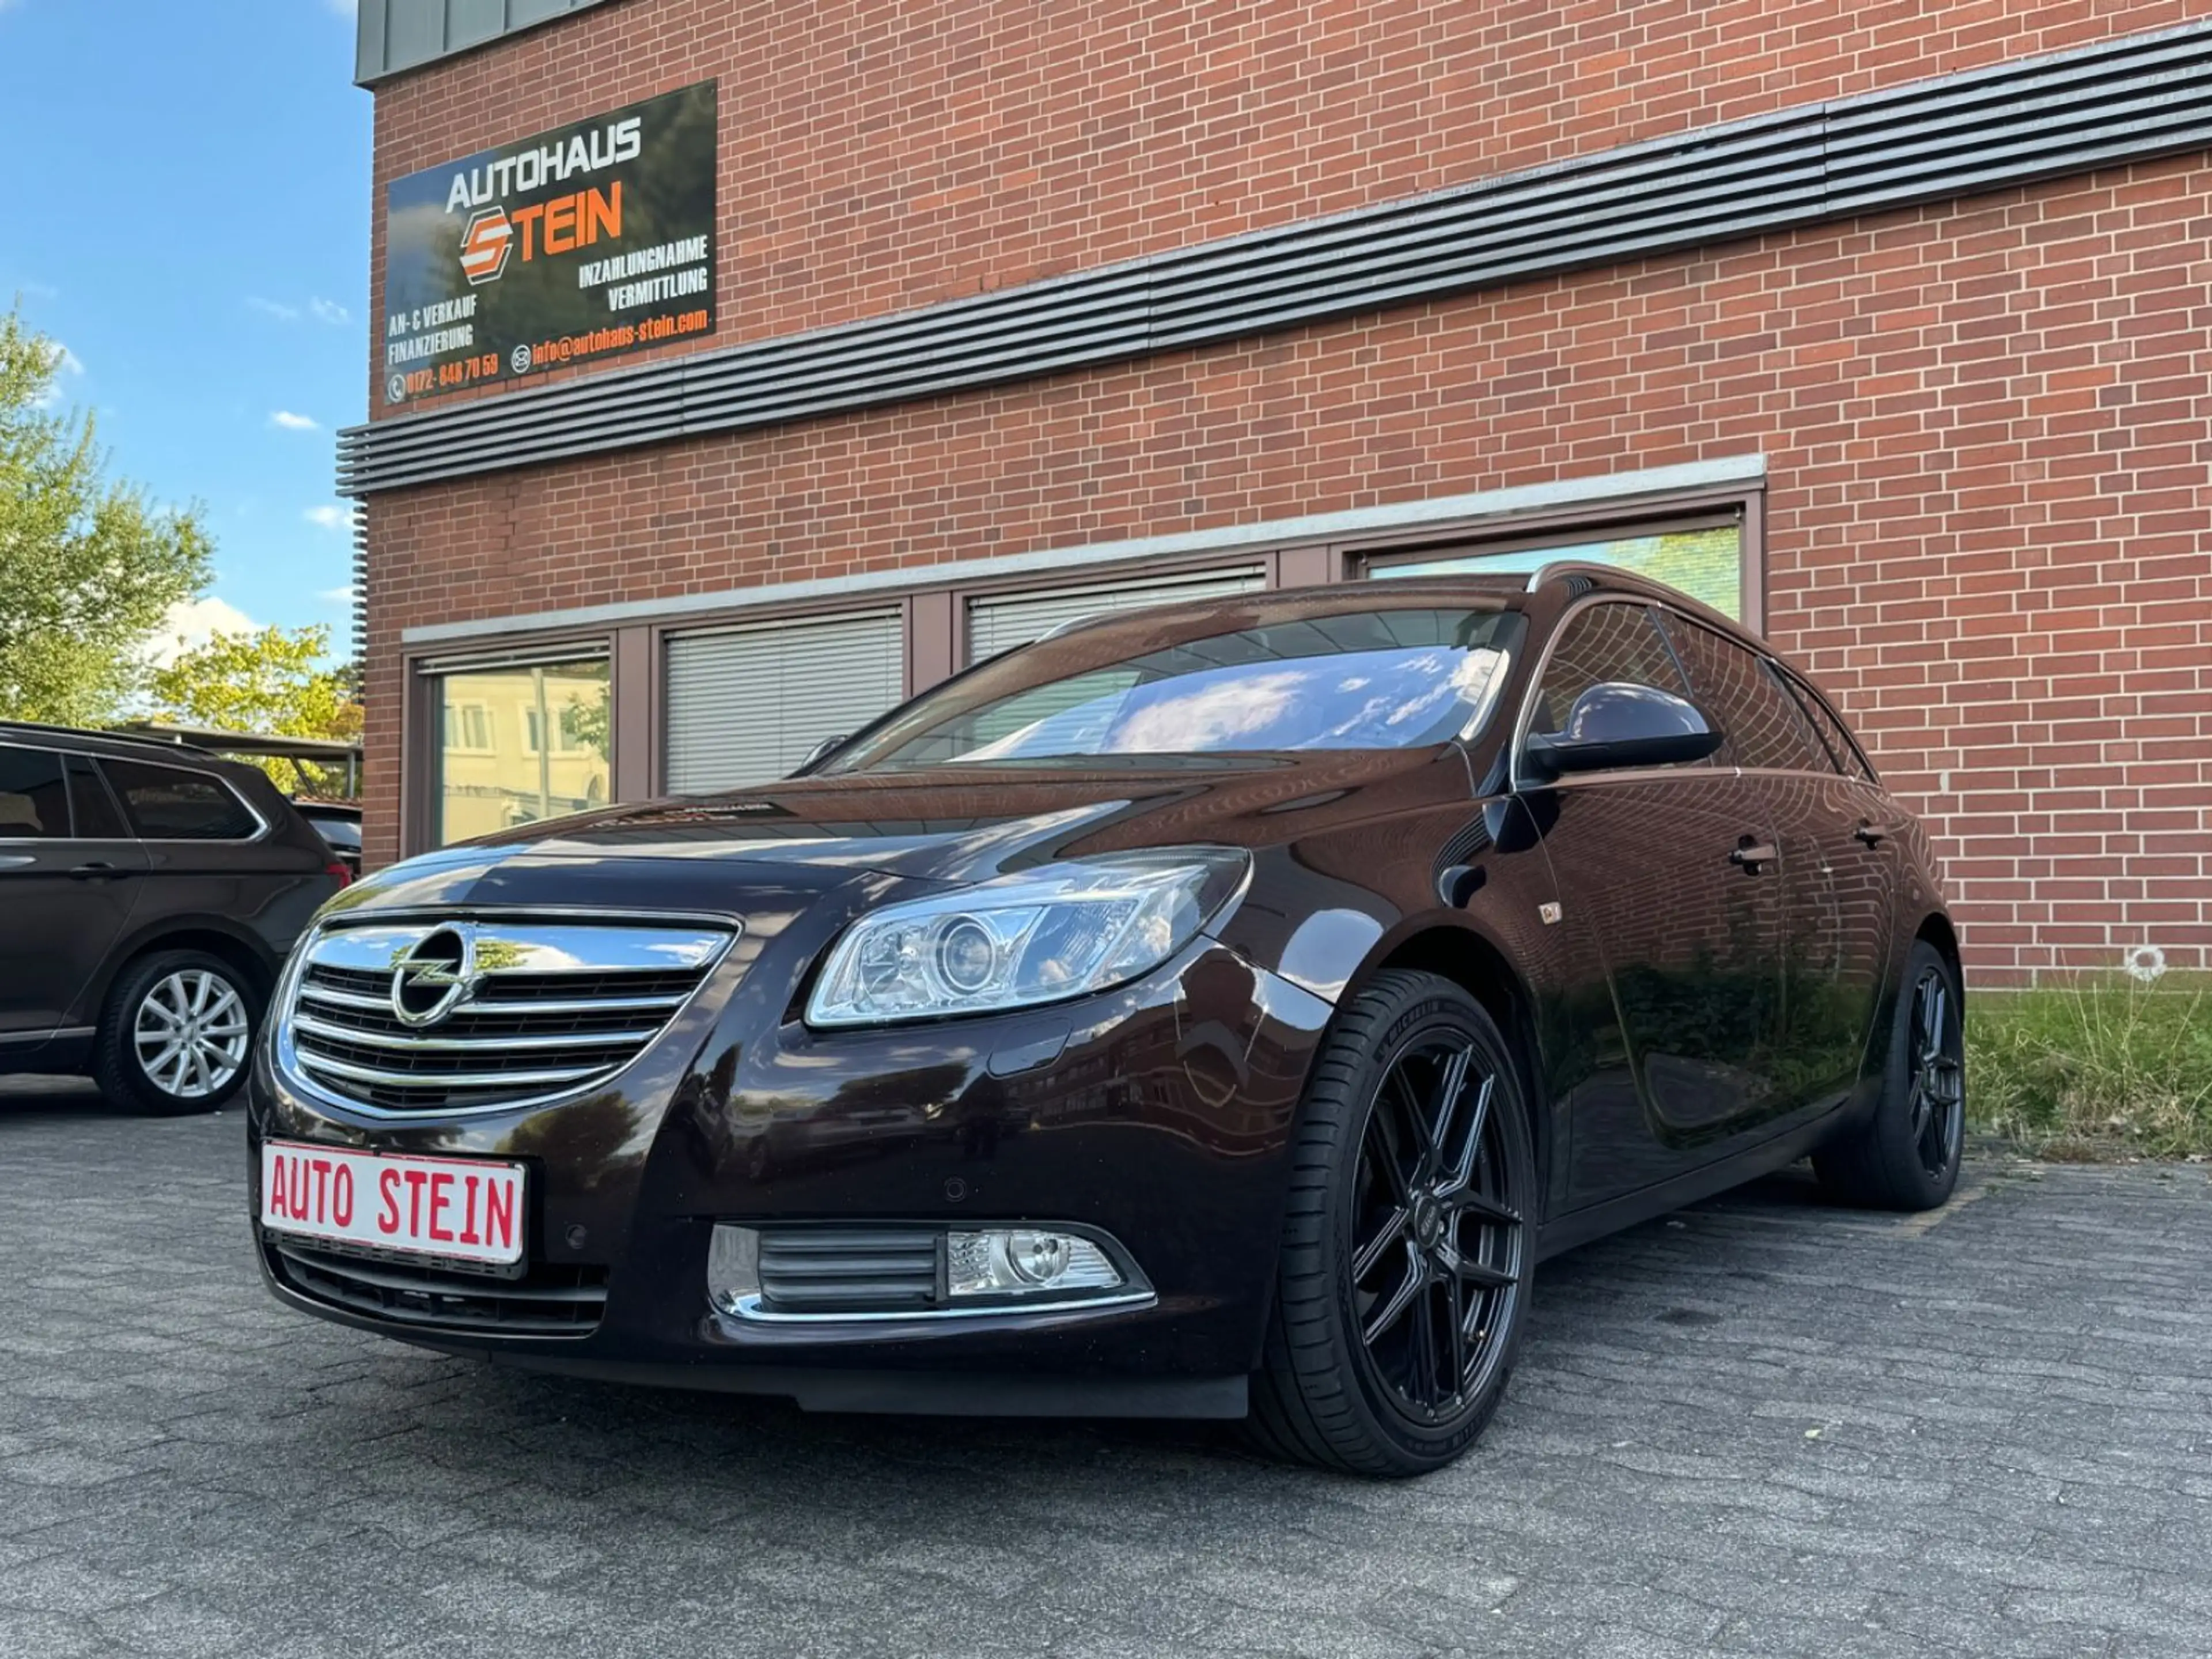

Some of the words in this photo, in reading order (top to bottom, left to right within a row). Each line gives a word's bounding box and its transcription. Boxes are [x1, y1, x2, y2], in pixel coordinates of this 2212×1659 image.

[445, 117, 642, 214] AUTOHAUS
[460, 181, 622, 283] STEIN
[579, 234, 708, 289] INZAHLUNGNAHME
[412, 309, 421, 331] &
[423, 294, 478, 327] VERKAUF
[608, 267, 708, 312] VERMITTLUNG
[388, 324, 474, 365] FINANZIERUNG
[532, 310, 707, 362] info@autohaus-stein.com
[465, 357, 480, 380] 70
[483, 353, 498, 376] 59
[271, 1154, 354, 1227] AUTO
[378, 1168, 513, 1248] STEIN
